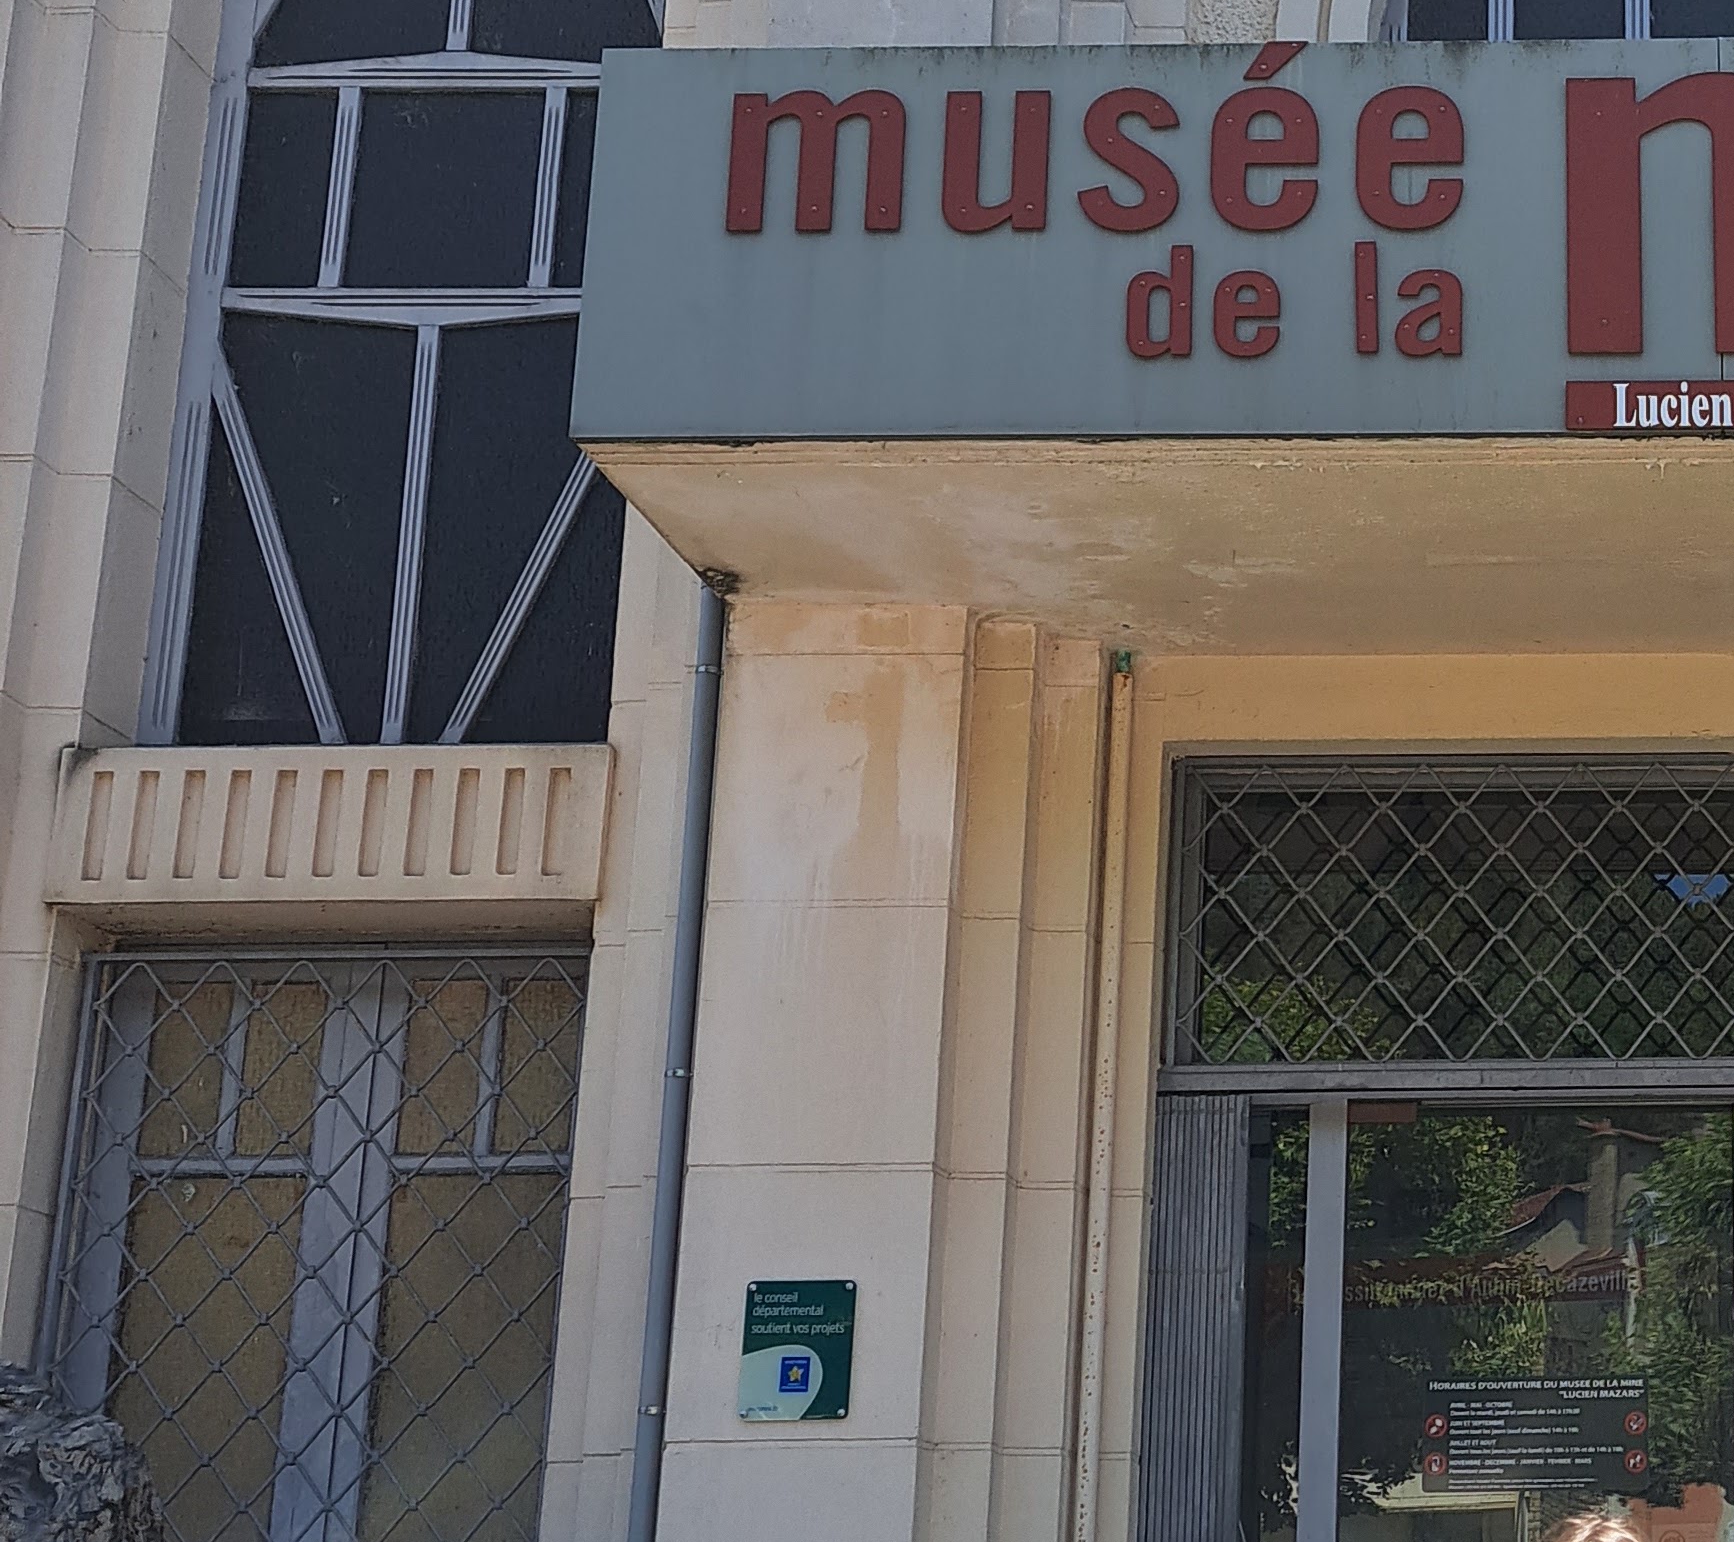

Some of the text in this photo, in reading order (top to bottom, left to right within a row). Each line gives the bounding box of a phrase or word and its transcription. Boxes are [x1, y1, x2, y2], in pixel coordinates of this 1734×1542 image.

[725, 40, 1464, 233] musée
[1125, 240, 1463, 358] de la
[1613, 381, 1733, 428] Lucien
[752, 1304, 824, 1318] départemental
[754, 1291, 799, 1303] le conseil
[750, 1321, 845, 1336] soutient vos projets
